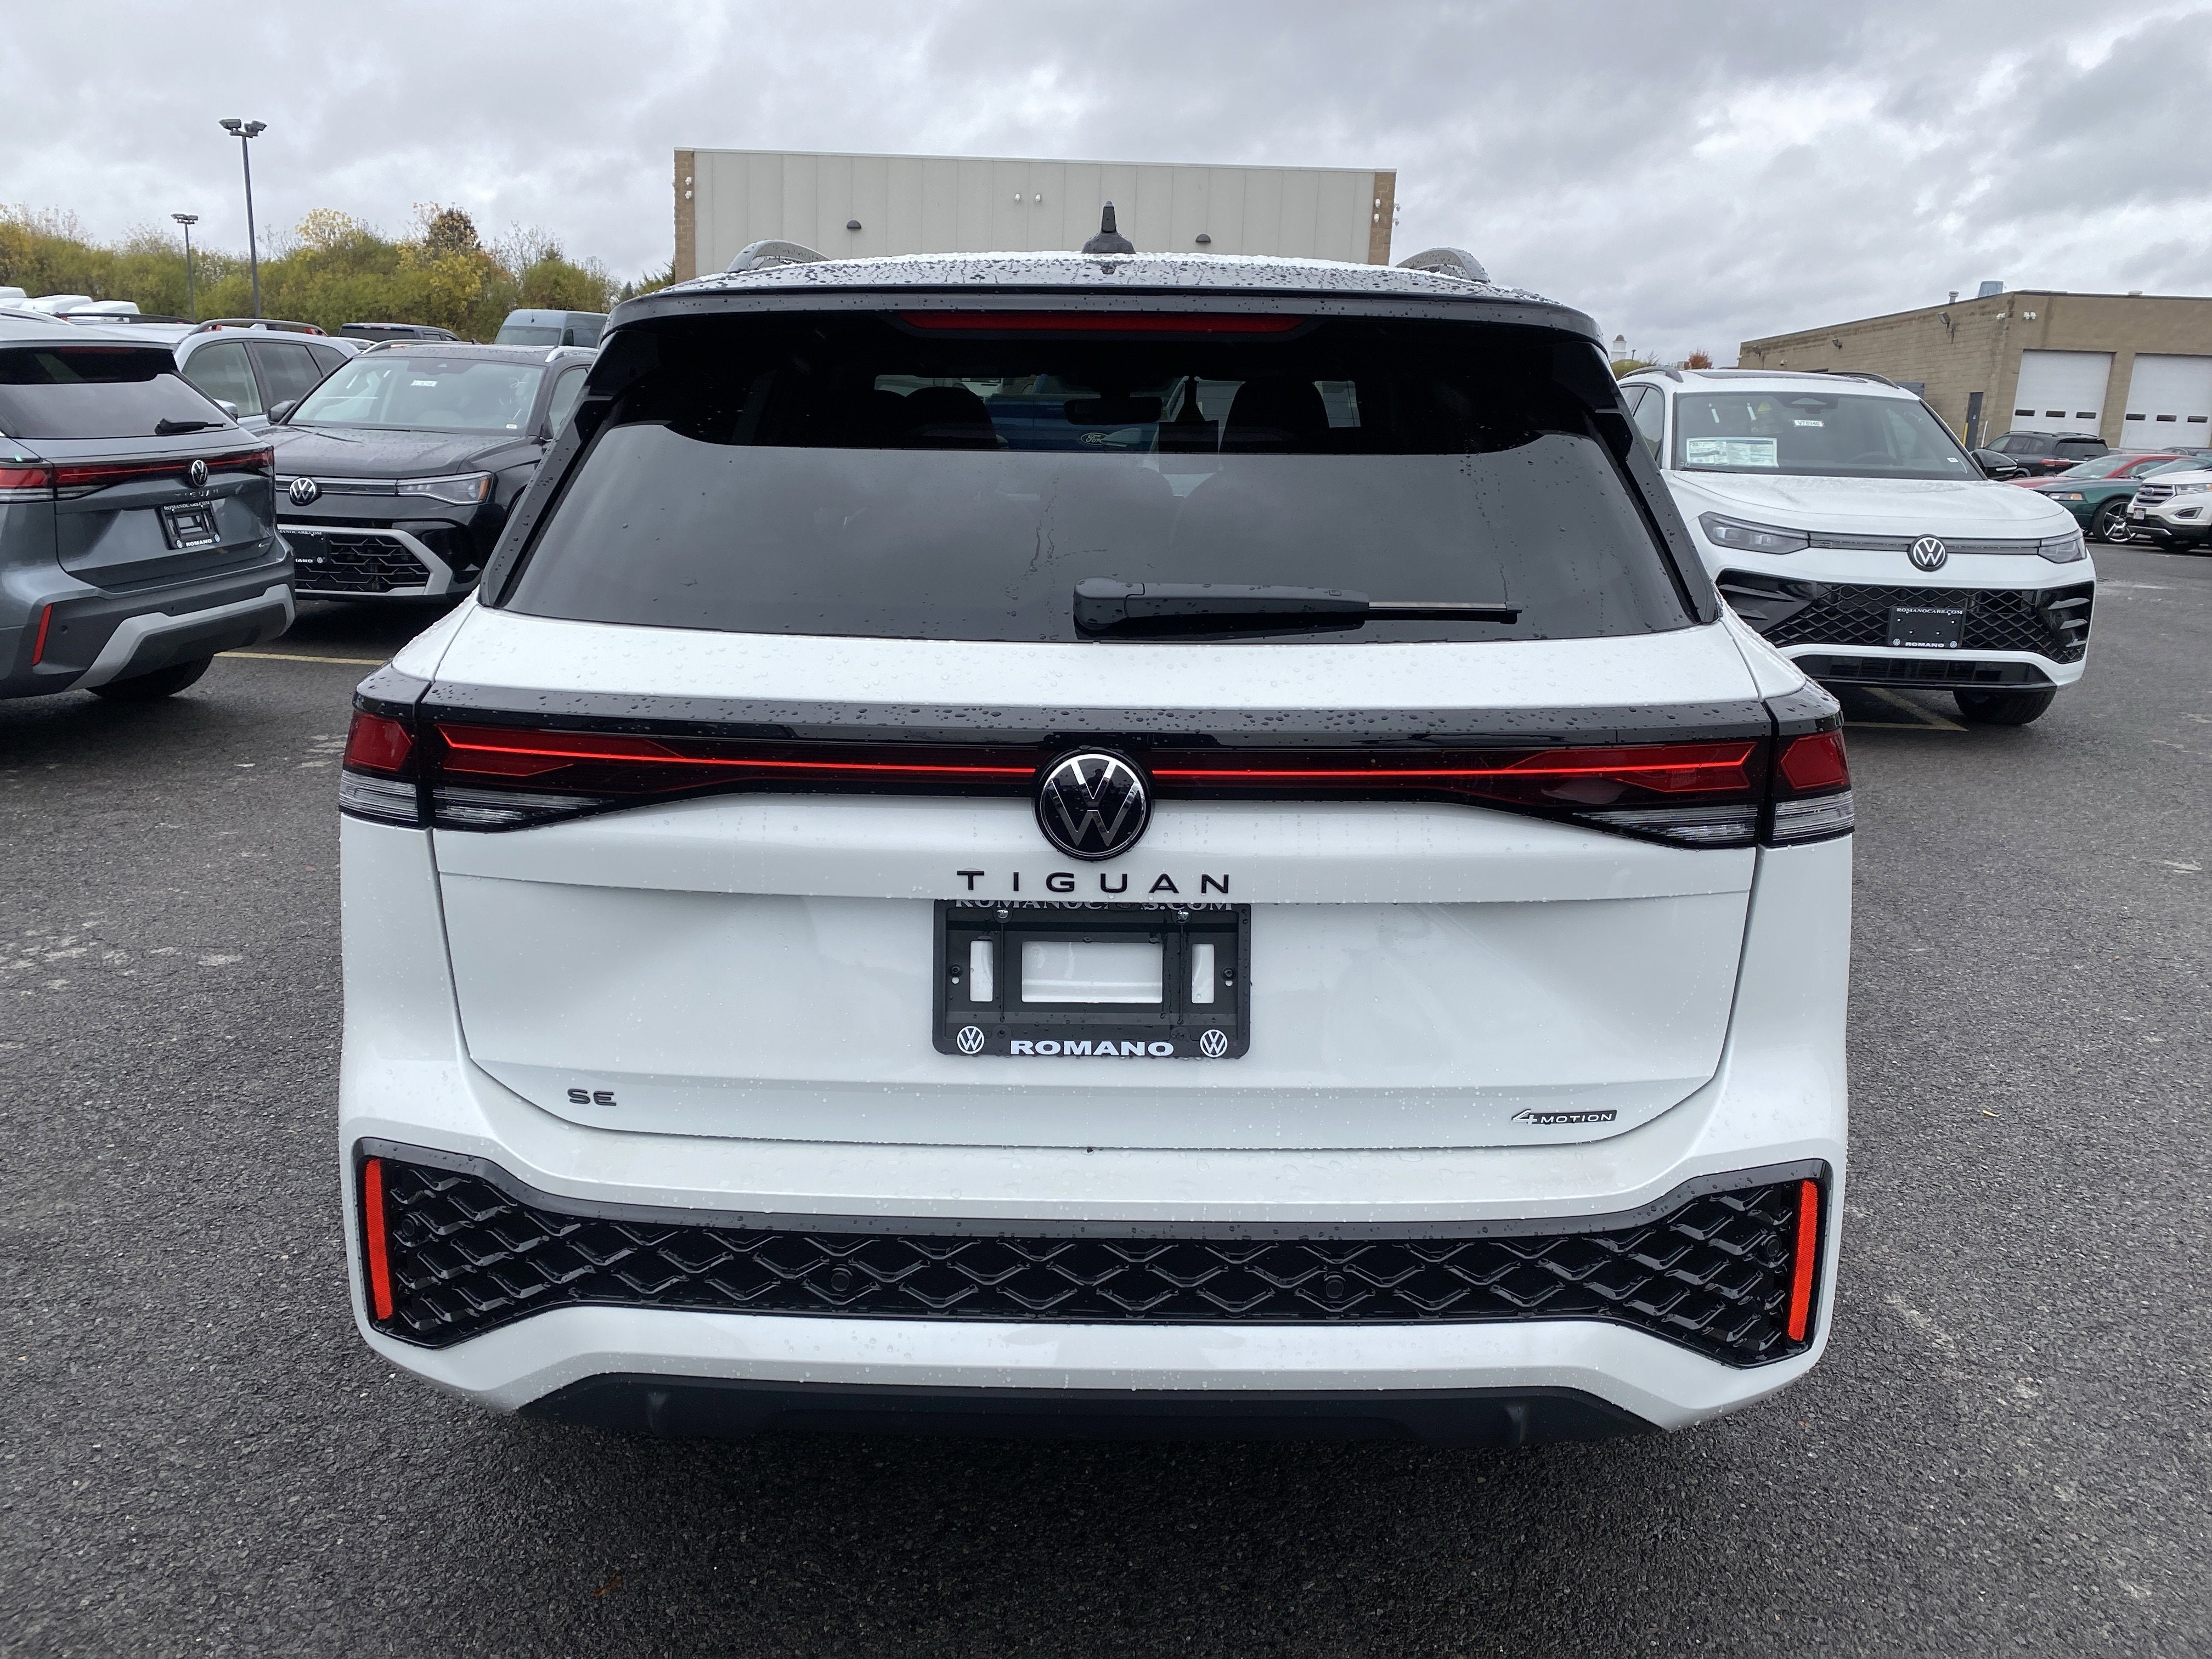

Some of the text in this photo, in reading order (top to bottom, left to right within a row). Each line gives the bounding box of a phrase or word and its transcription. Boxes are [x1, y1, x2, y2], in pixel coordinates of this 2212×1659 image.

[1086, 434, 1102, 443] For
[185, 539, 212, 547] ROMANO
[1912, 537, 1945, 568] VW
[1043, 753, 1146, 857] VW
[956, 870, 1229, 894] TIGUAN
[1011, 1040, 1174, 1057] ROMANO
[567, 1088, 617, 1106] SE
